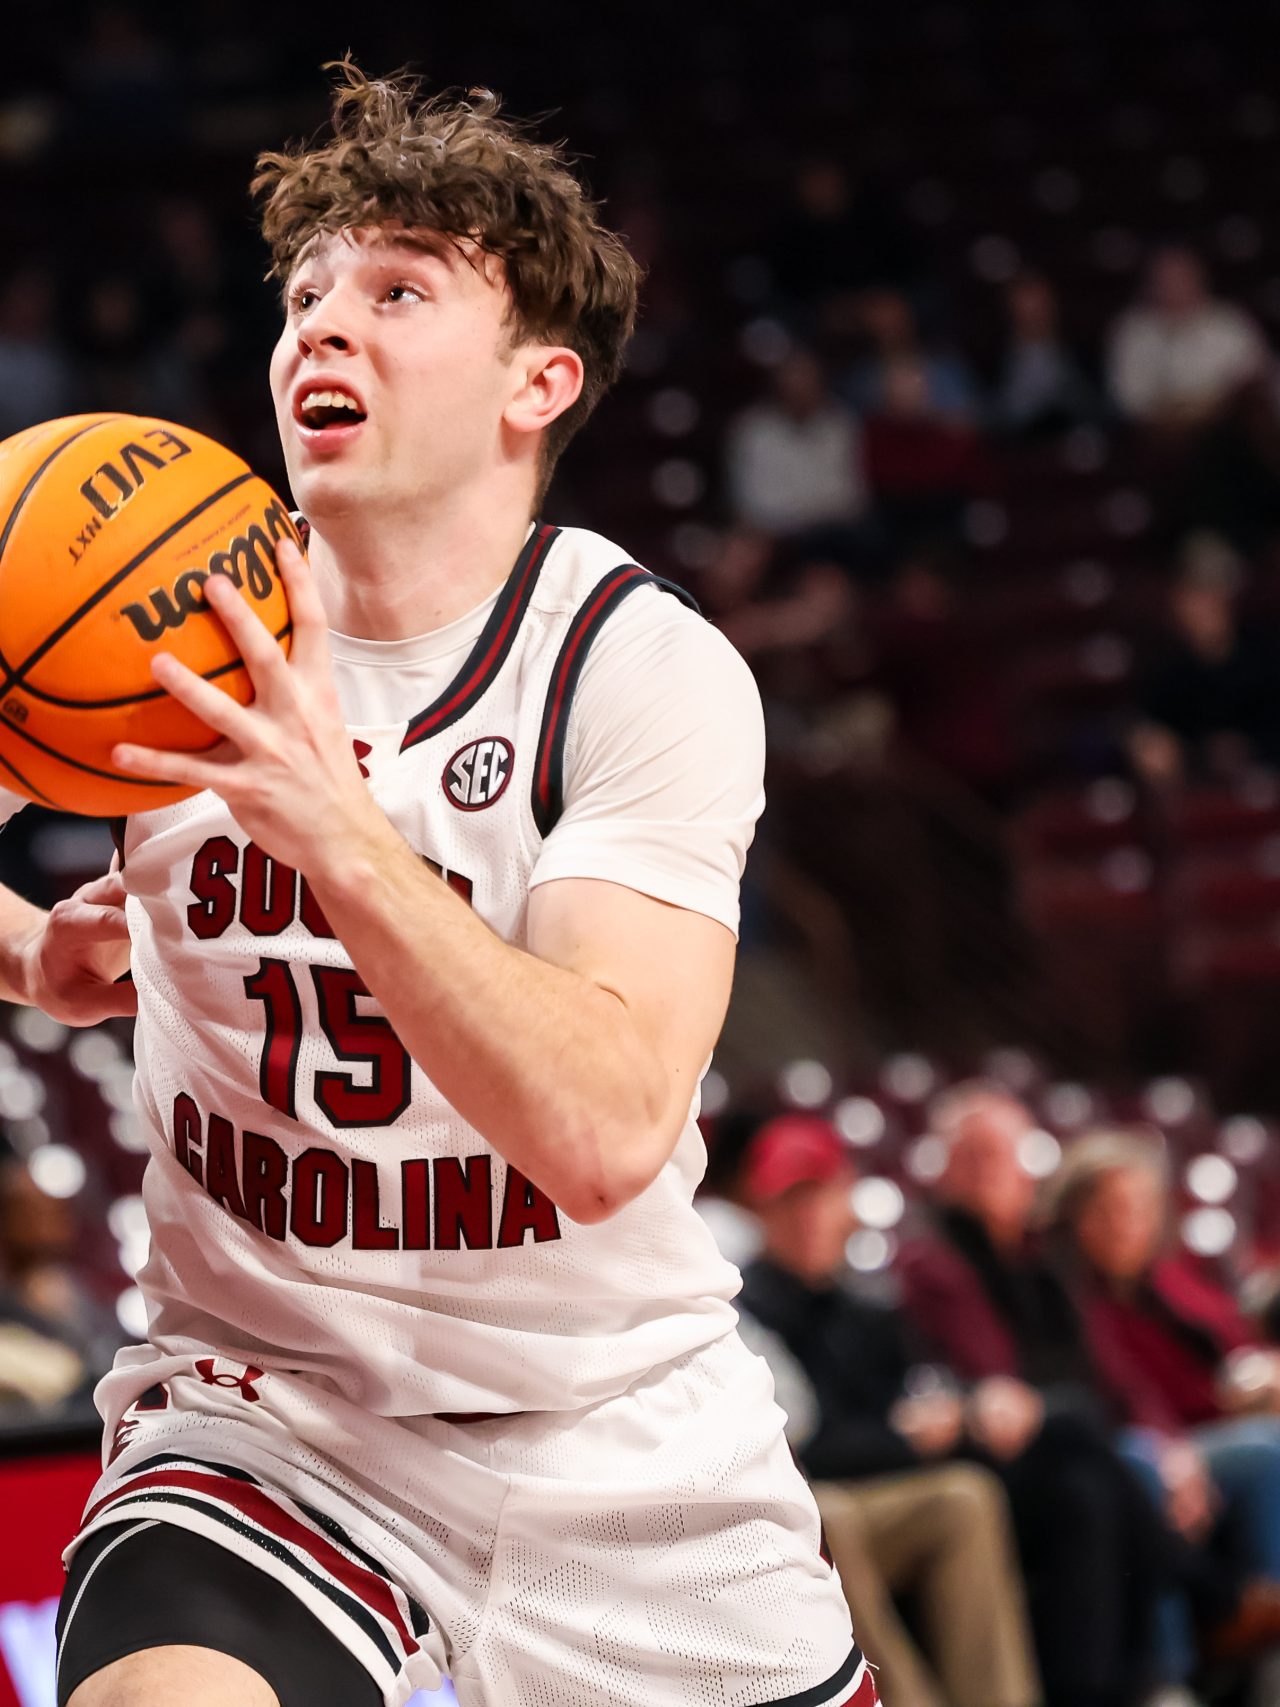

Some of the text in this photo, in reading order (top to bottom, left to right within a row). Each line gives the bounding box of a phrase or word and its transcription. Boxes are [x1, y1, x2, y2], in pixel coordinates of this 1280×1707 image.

[68, 429, 192, 566] EVO NXT
[449, 741, 509, 805] SEC
[243, 956, 411, 1128] 15
[173, 1091, 562, 1251] CAROLINA
